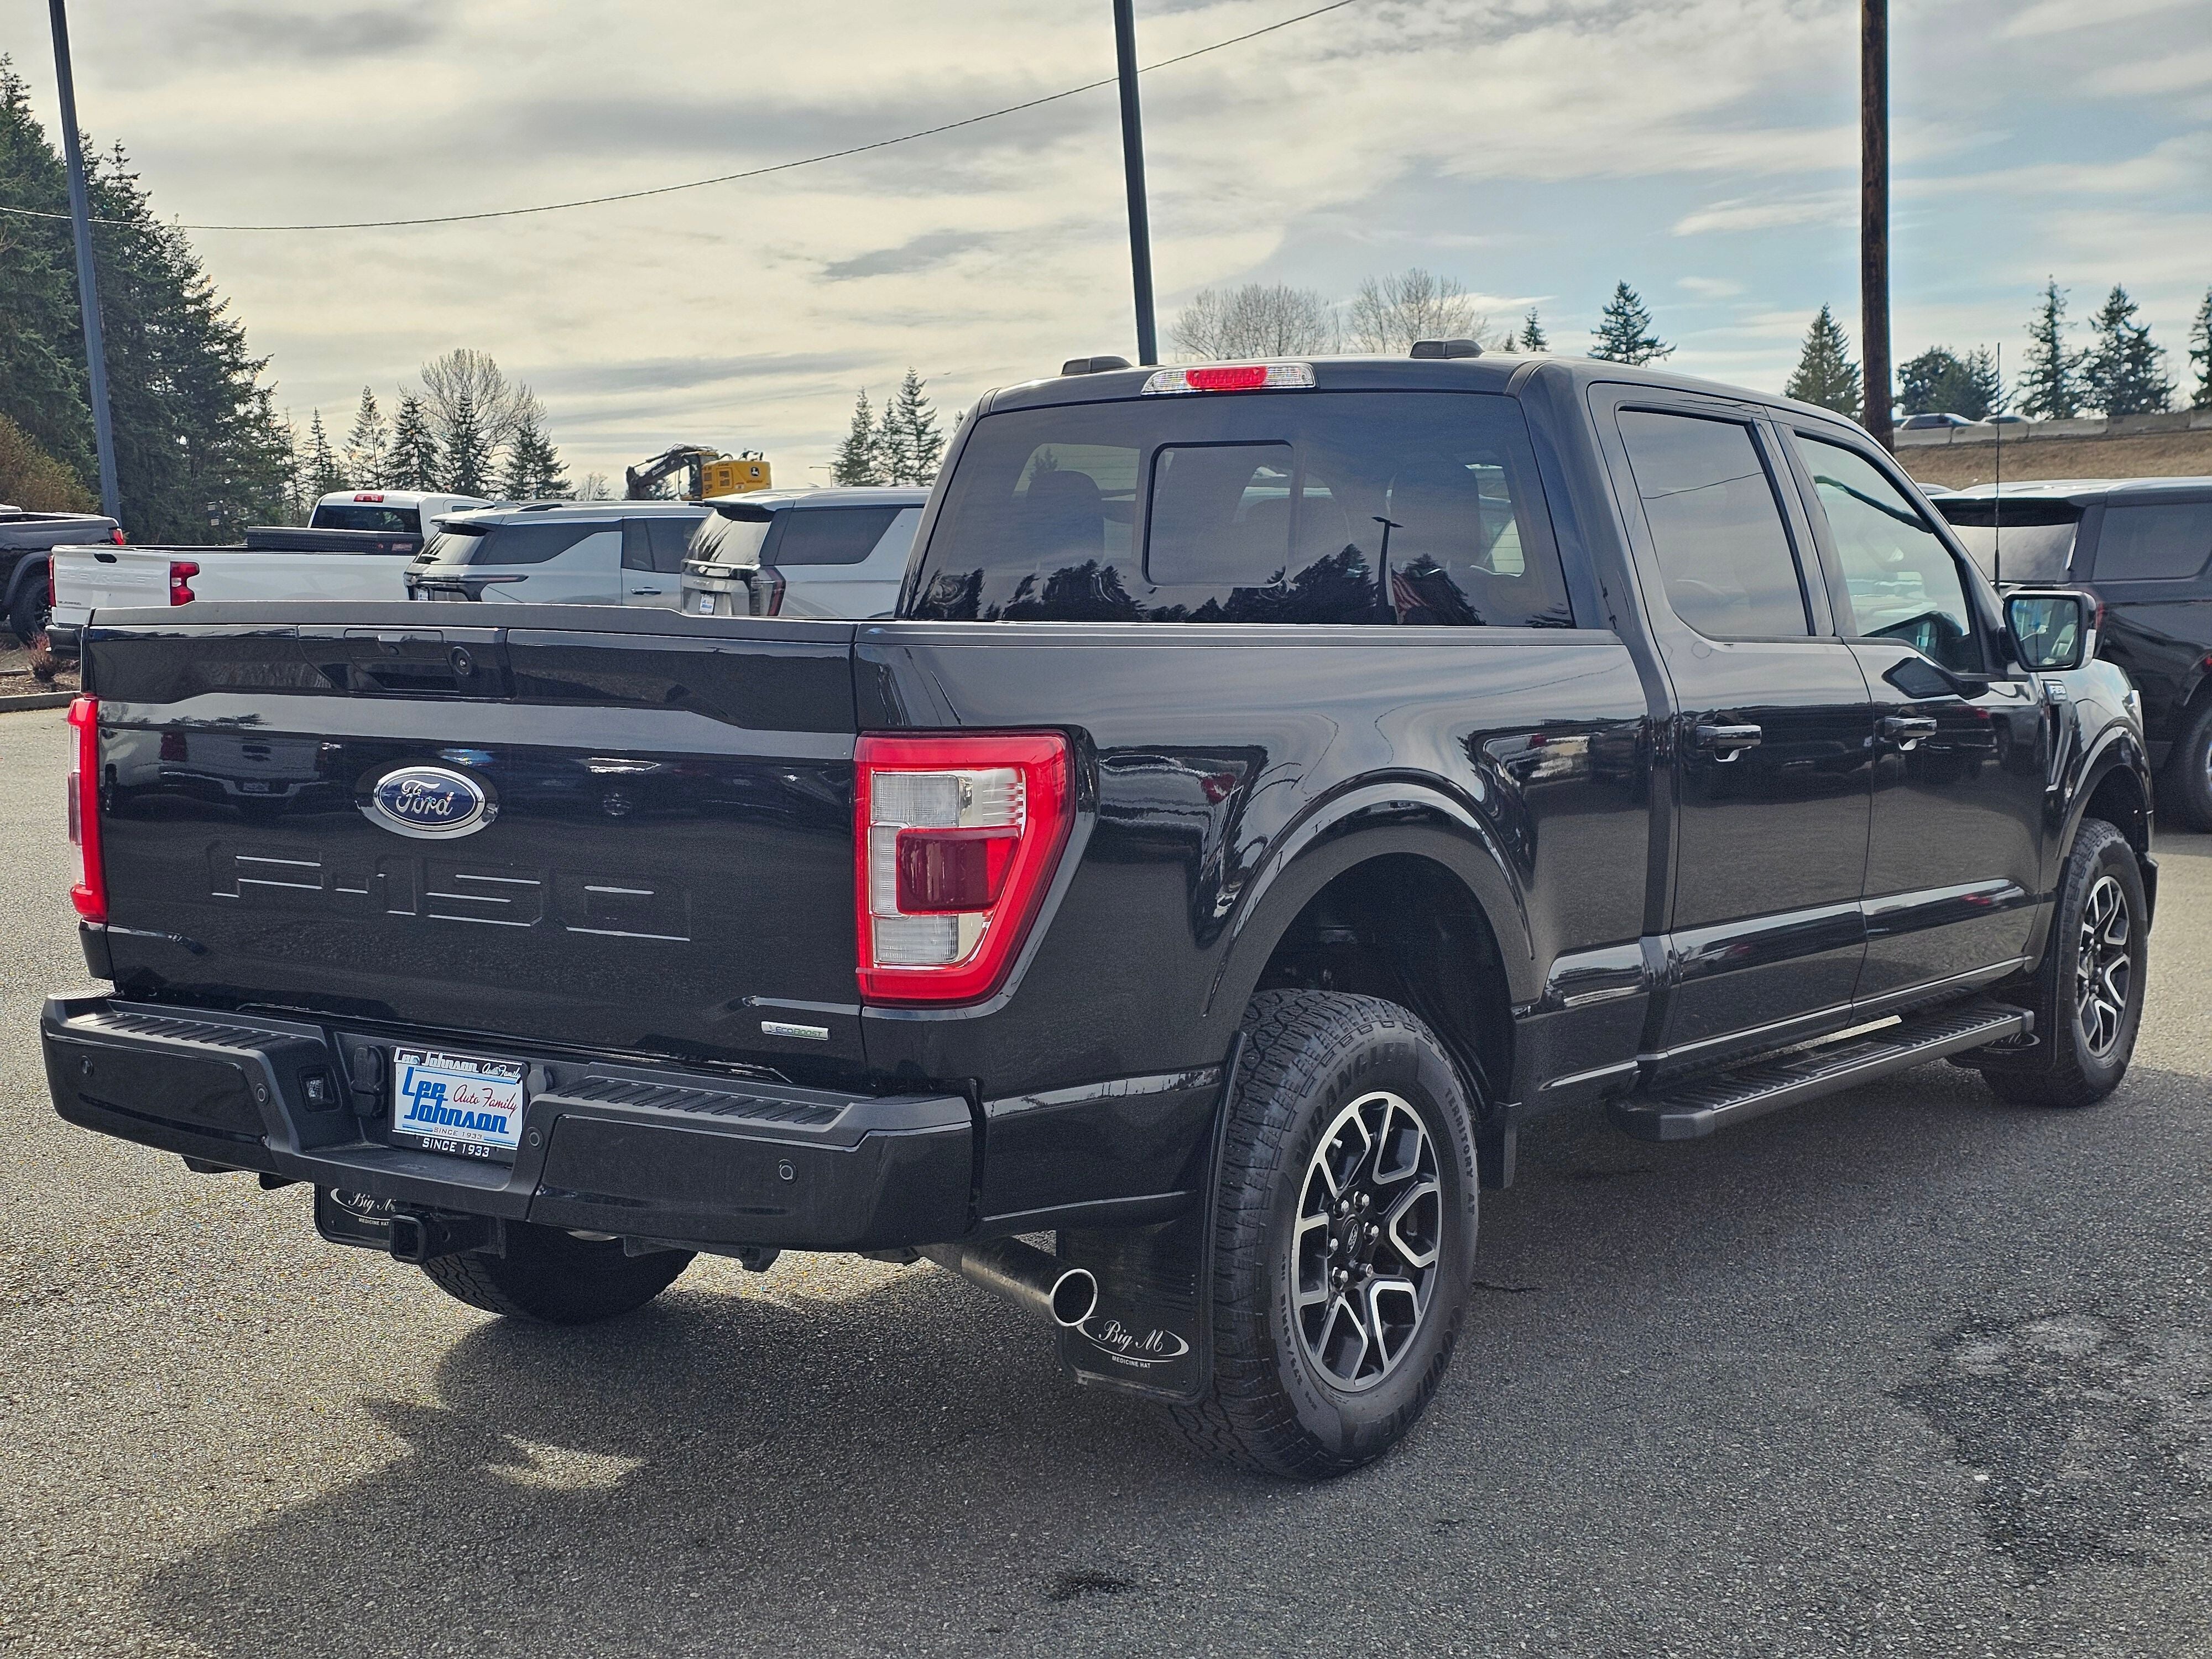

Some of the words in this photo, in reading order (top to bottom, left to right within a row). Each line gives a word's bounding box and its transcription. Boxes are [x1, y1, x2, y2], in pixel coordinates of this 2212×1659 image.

[395, 779, 453, 816] Ford
[775, 1026, 823, 1037] ECOBOOST
[421, 1051, 479, 1073] Johnson
[498, 1064, 521, 1079] Family
[402, 1066, 448, 1102] Lee
[453, 1084, 480, 1105] Auto
[481, 1087, 518, 1118] Family
[404, 1094, 509, 1134] Johnson
[434, 1127, 458, 1136] SINCE
[462, 1131, 483, 1140] 1933
[1445, 1087, 1474, 1178] TERRITORY
[422, 1137, 457, 1152] SINCE
[461, 1145, 491, 1158] 1933
[348, 1191, 375, 1214] Big
[1098, 1319, 1133, 1352] Big
[1135, 1329, 1164, 1352] M
[1112, 1355, 1139, 1368] MEDICINE
